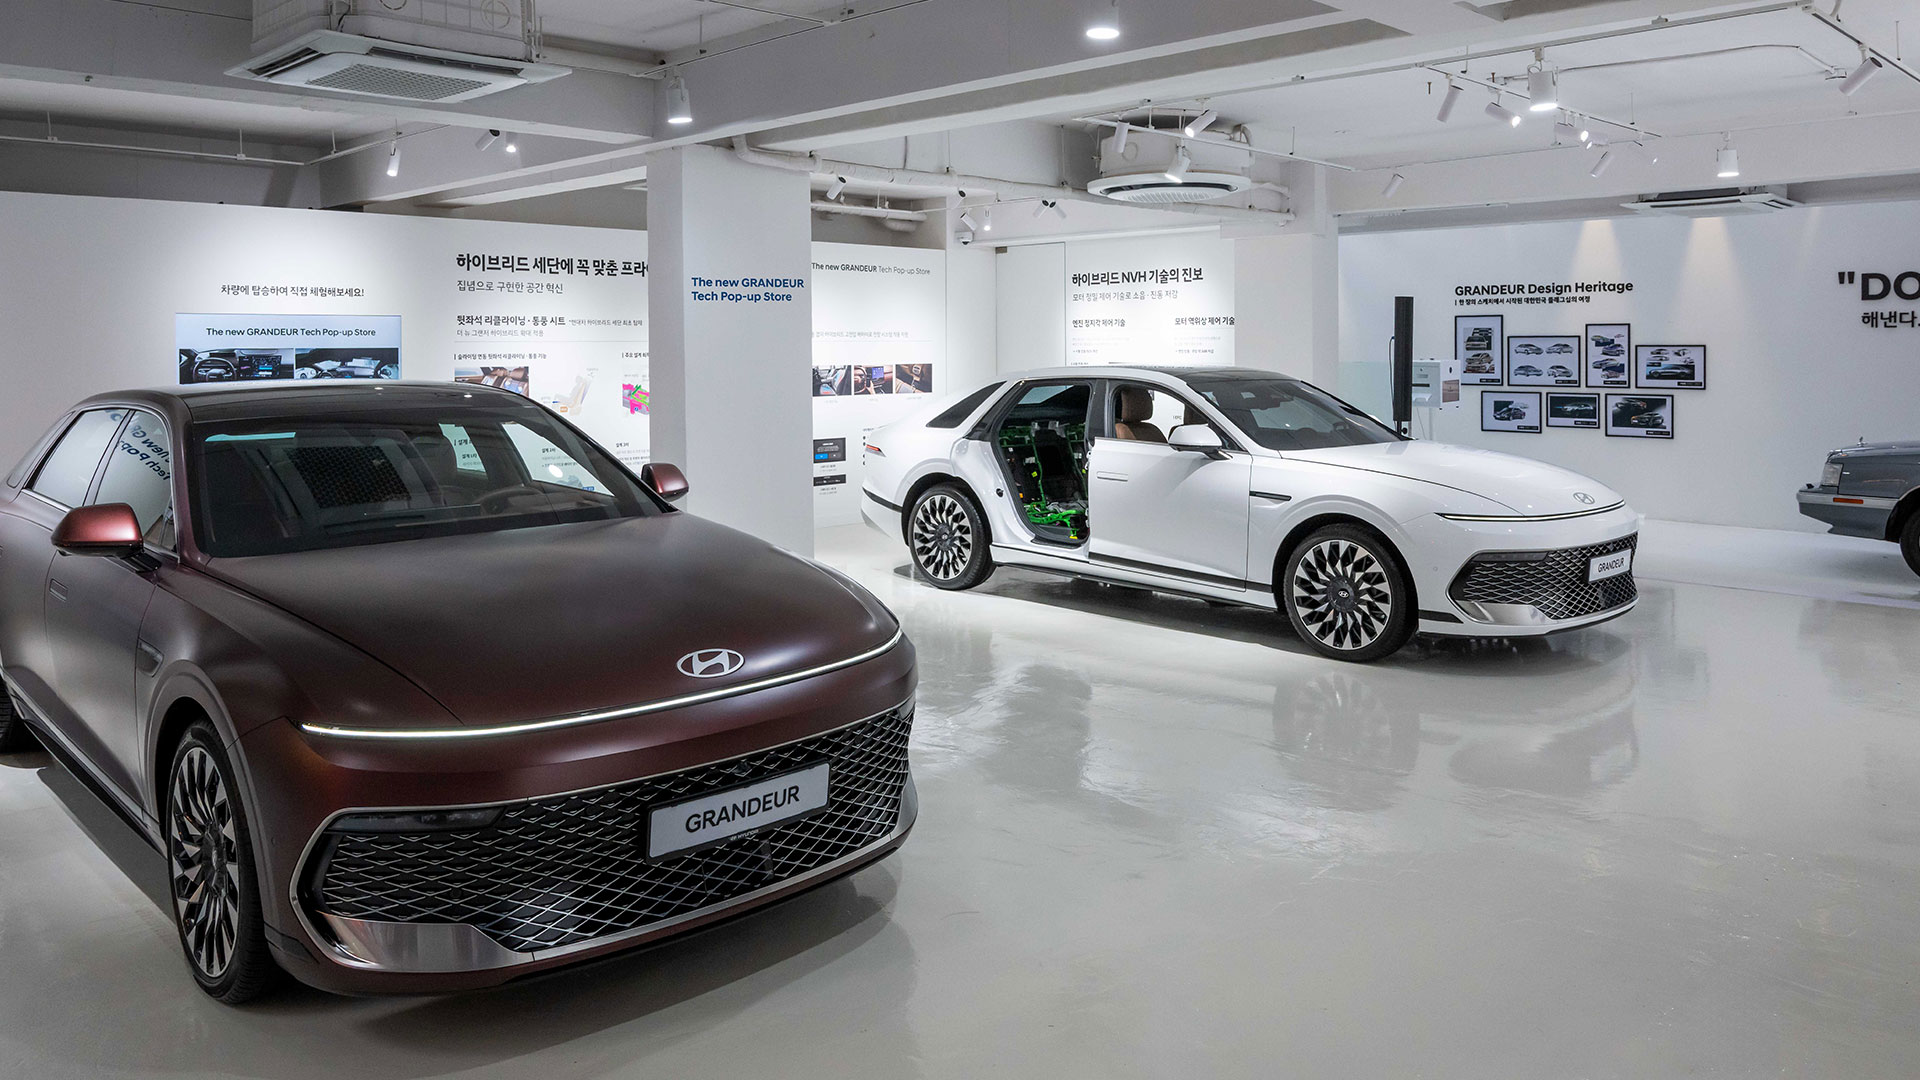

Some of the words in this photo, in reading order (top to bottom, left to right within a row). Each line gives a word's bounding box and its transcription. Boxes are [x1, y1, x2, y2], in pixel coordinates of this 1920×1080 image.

[456, 254, 530, 272] 하이브리드
[532, 257, 574, 274] 세단에
[576, 259, 590, 276] 꼭
[592, 260, 618, 276] 맞춘
[811, 262, 824, 270] The
[840, 264, 877, 272] GRANDEUR
[878, 266, 893, 274] Tech
[894, 266, 914, 276] Pop-up
[916, 267, 930, 275] Store
[692, 277, 712, 287] The
[716, 279, 739, 288] new
[742, 278, 804, 288] GRANDEUR
[1072, 272, 1120, 286] 하이브리드
[1122, 272, 1146, 284] NVH
[1149, 269, 1179, 284] 기술의
[1182, 268, 1204, 282] 진보
[220, 284, 250, 296] 차량에
[251, 286, 288, 296] 탑승하여
[290, 286, 308, 296] 직접
[310, 288, 365, 298] 체험해보세요!
[457, 280, 494, 292] 집념으로
[496, 282, 524, 292] 구현한
[526, 283, 544, 294] 공간
[546, 284, 564, 294] 혁신
[1455, 284, 1525, 296] GRANDEUR
[1528, 283, 1572, 296] Design
[1575, 281, 1634, 294] Heritage
[692, 292, 718, 301] Tech
[720, 292, 761, 303] Pop-up
[764, 292, 792, 302] Store
[1072, 293, 1084, 302] 모터
[1132, 290, 1146, 300] 소음
[457, 315, 482, 326] 뒷좌석
[484, 316, 526, 326] 리클라이닝
[550, 316, 566, 326] 시트
[206, 326, 223, 336] The
[246, 328, 298, 336] GRANDEUR
[300, 328, 320, 336] Tech
[322, 328, 353, 338] Pop-up
[354, 328, 376, 336] Store
[1598, 557, 1624, 573] GRANDEUR
[685, 785, 800, 834] GRANDEUR
